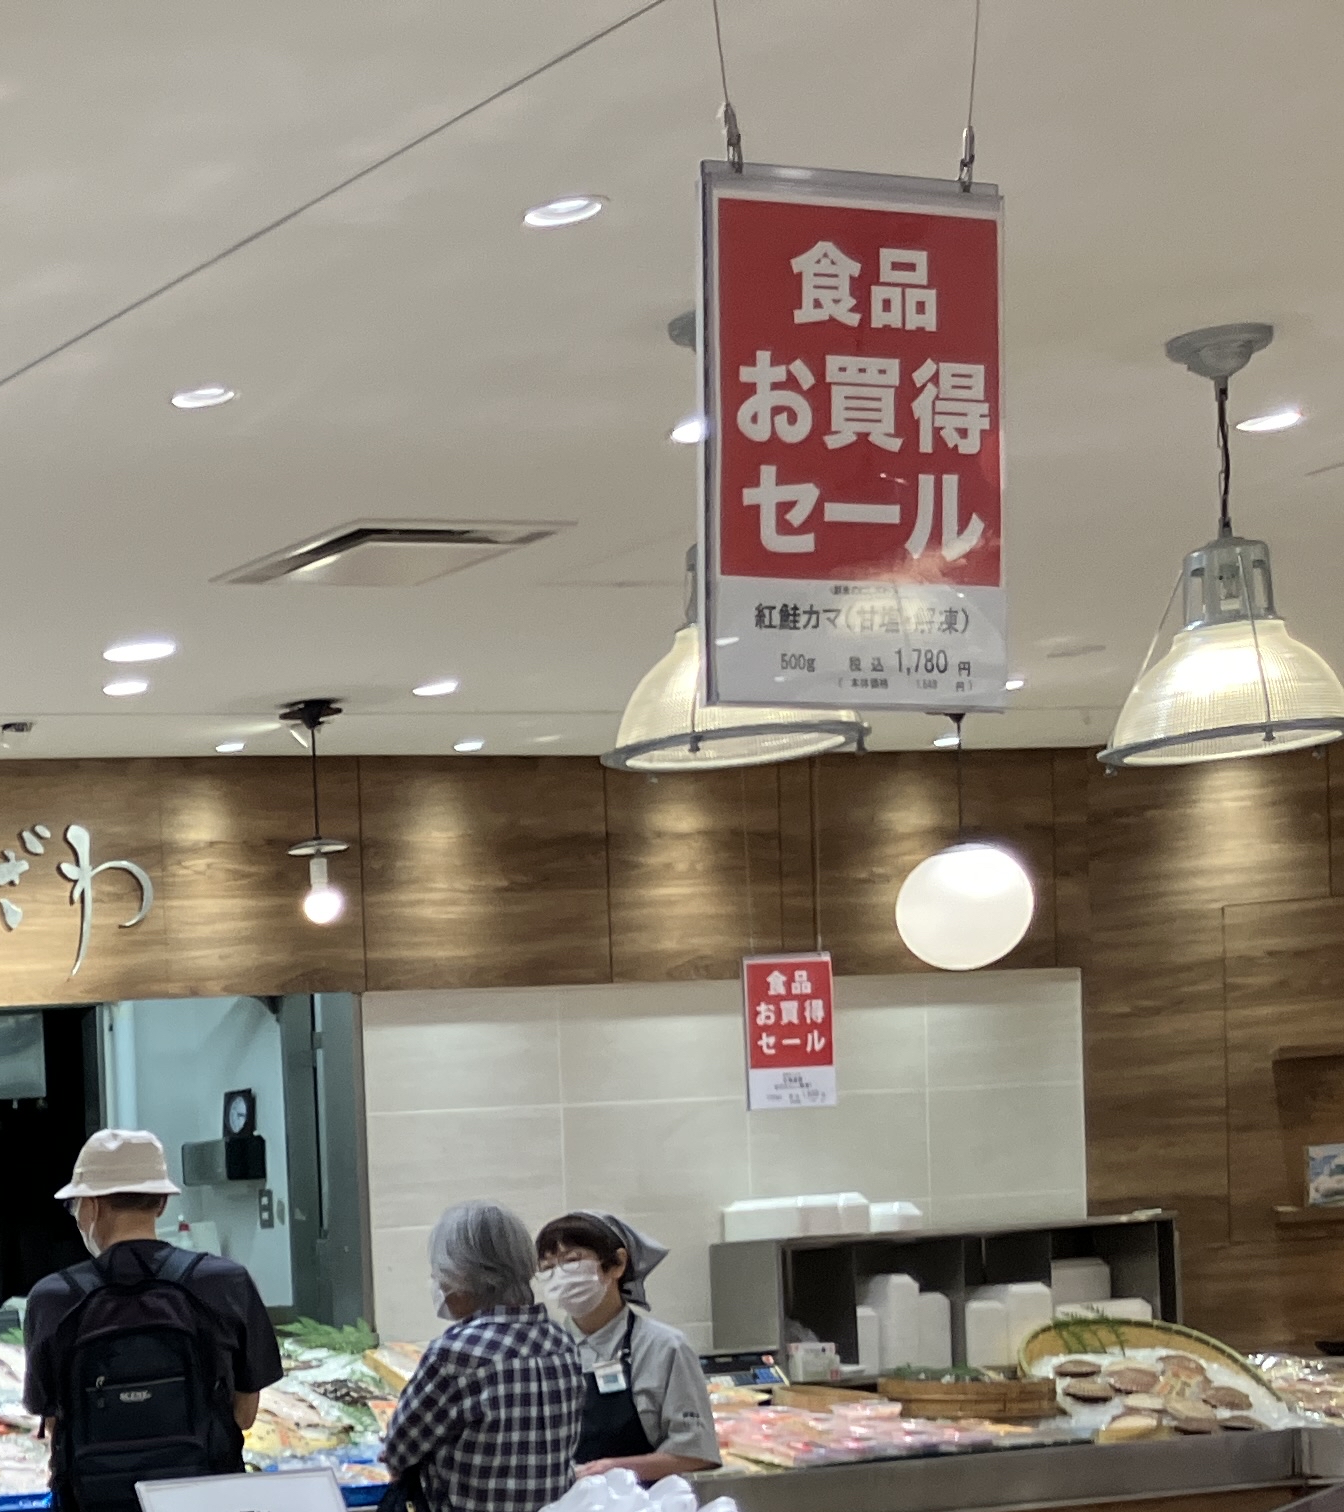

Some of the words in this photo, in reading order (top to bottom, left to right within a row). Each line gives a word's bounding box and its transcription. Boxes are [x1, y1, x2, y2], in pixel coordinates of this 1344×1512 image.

[790, 240, 937, 332] 食品
[736, 350, 990, 454] お買得
[742, 464, 985, 562] セール
[780, 653, 816, 672] 500g
[895, 649, 948, 675] 1,780
[958, 660, 971, 677] 円
[766, 969, 812, 996] 食品
[756, 998, 825, 1026] お買得
[757, 1029, 826, 1056] セール
